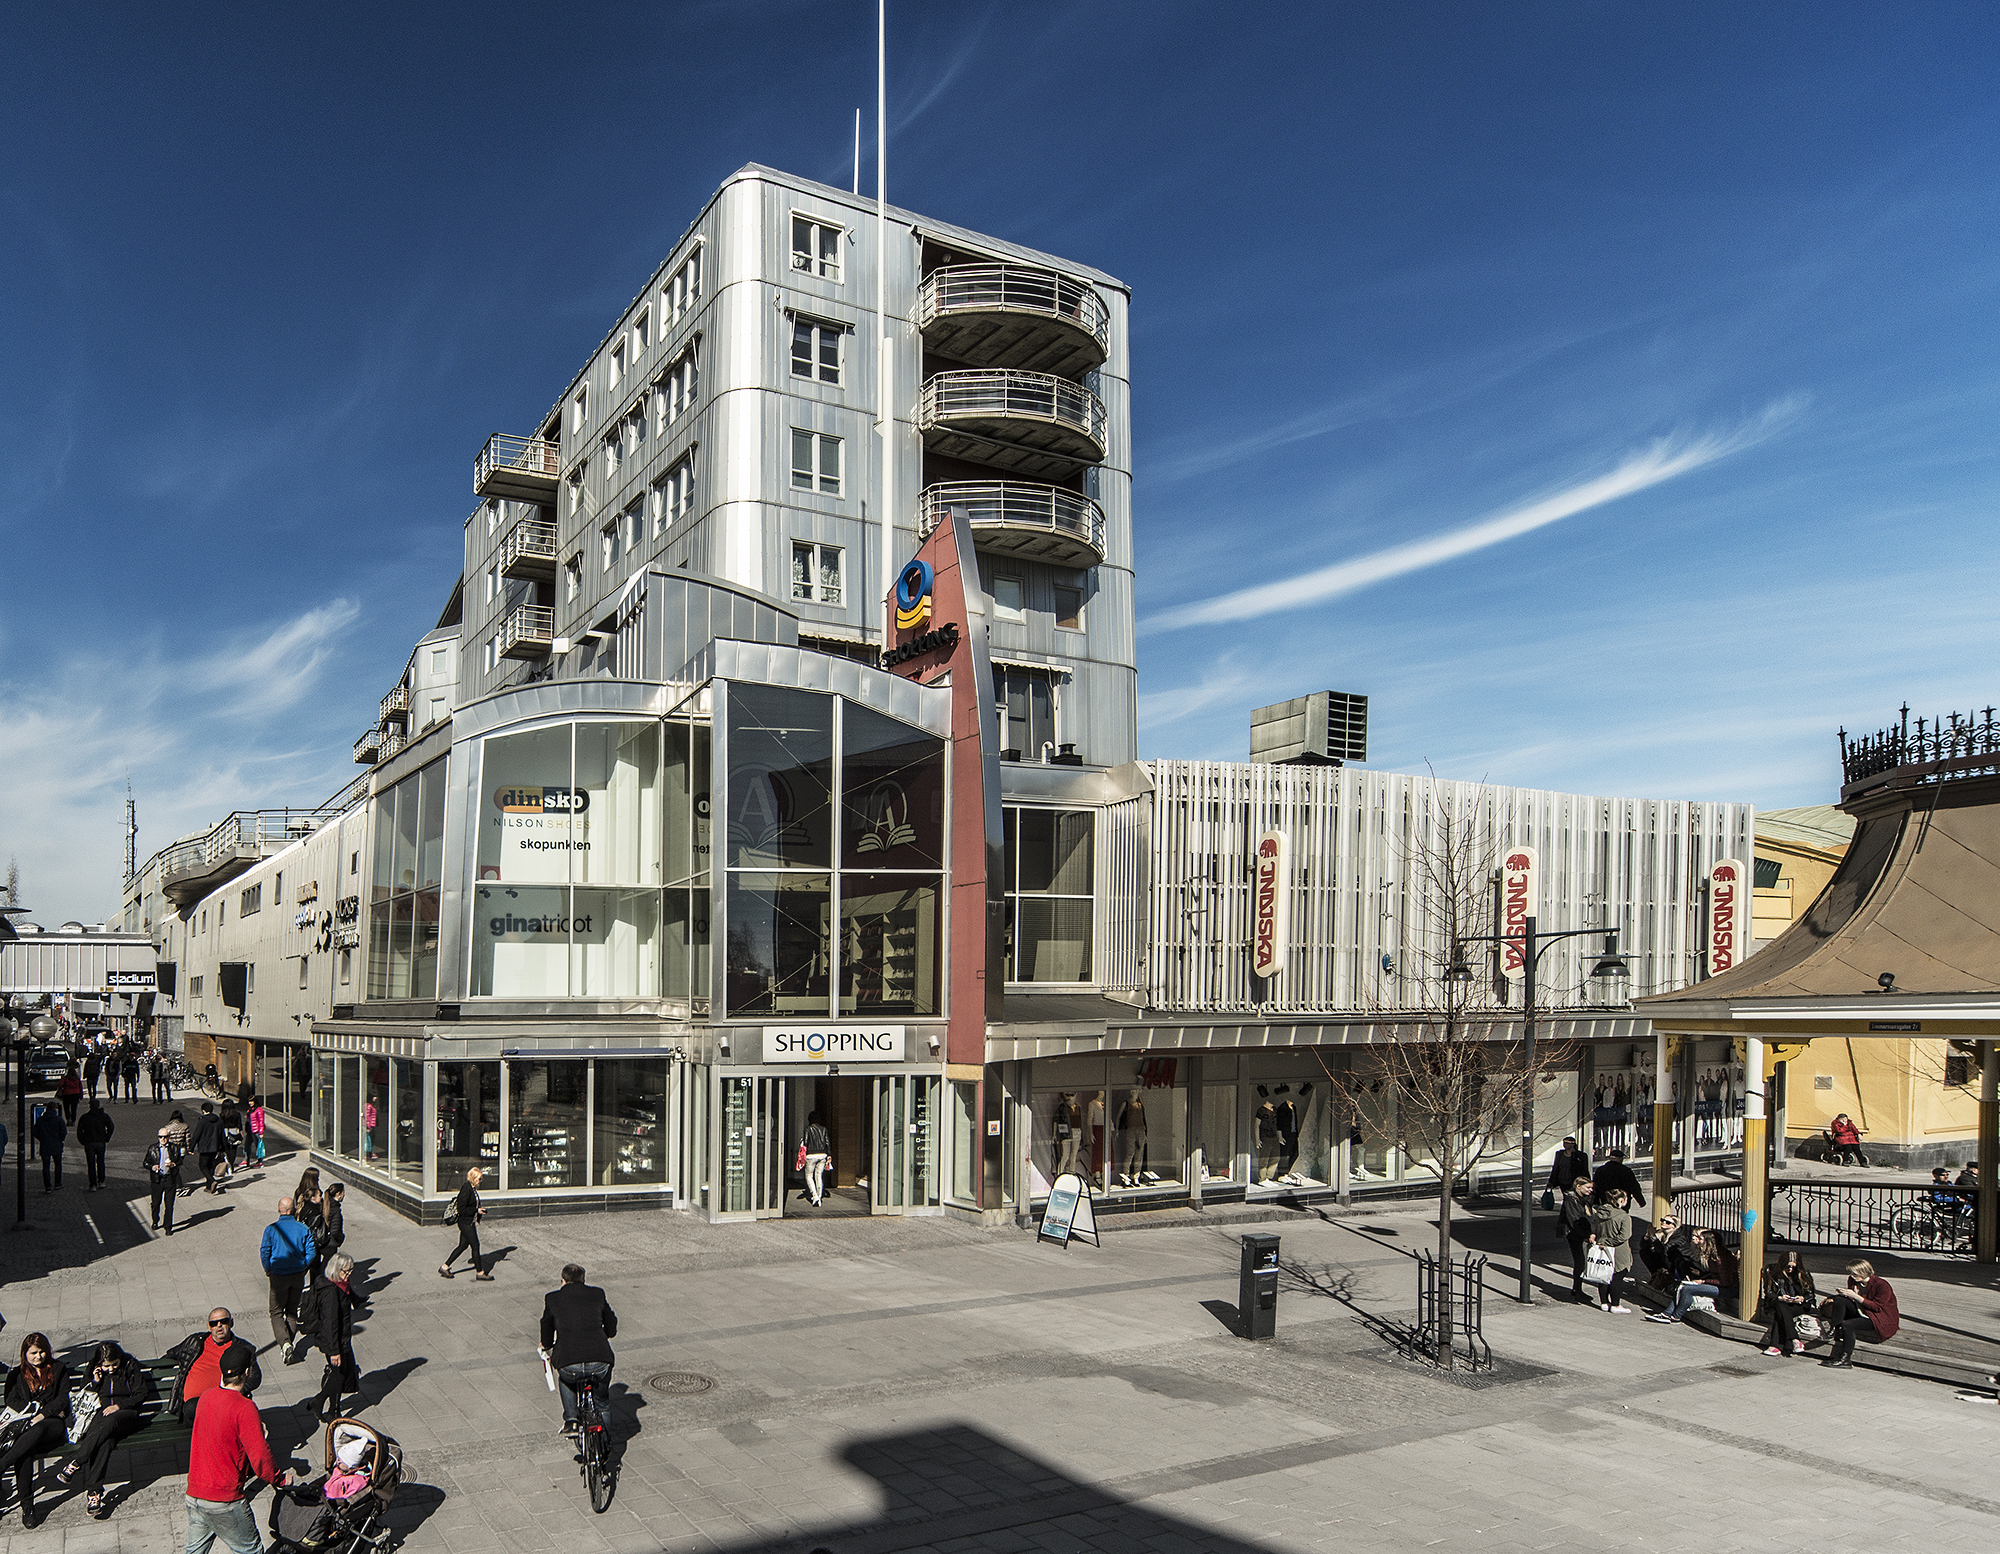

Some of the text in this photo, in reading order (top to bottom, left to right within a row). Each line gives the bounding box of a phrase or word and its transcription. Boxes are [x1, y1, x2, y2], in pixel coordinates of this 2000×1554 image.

[881, 622, 959, 667] SHOPPING
[493, 818, 543, 829] NILSON
[519, 838, 591, 852] skopunkten
[1256, 861, 1276, 970] INDISKA
[1712, 884, 1734, 974] INDISKA
[775, 1032, 893, 1052] SHOPPING
[740, 1078, 752, 1087] 51
[1140, 1057, 1178, 1090] H&M
